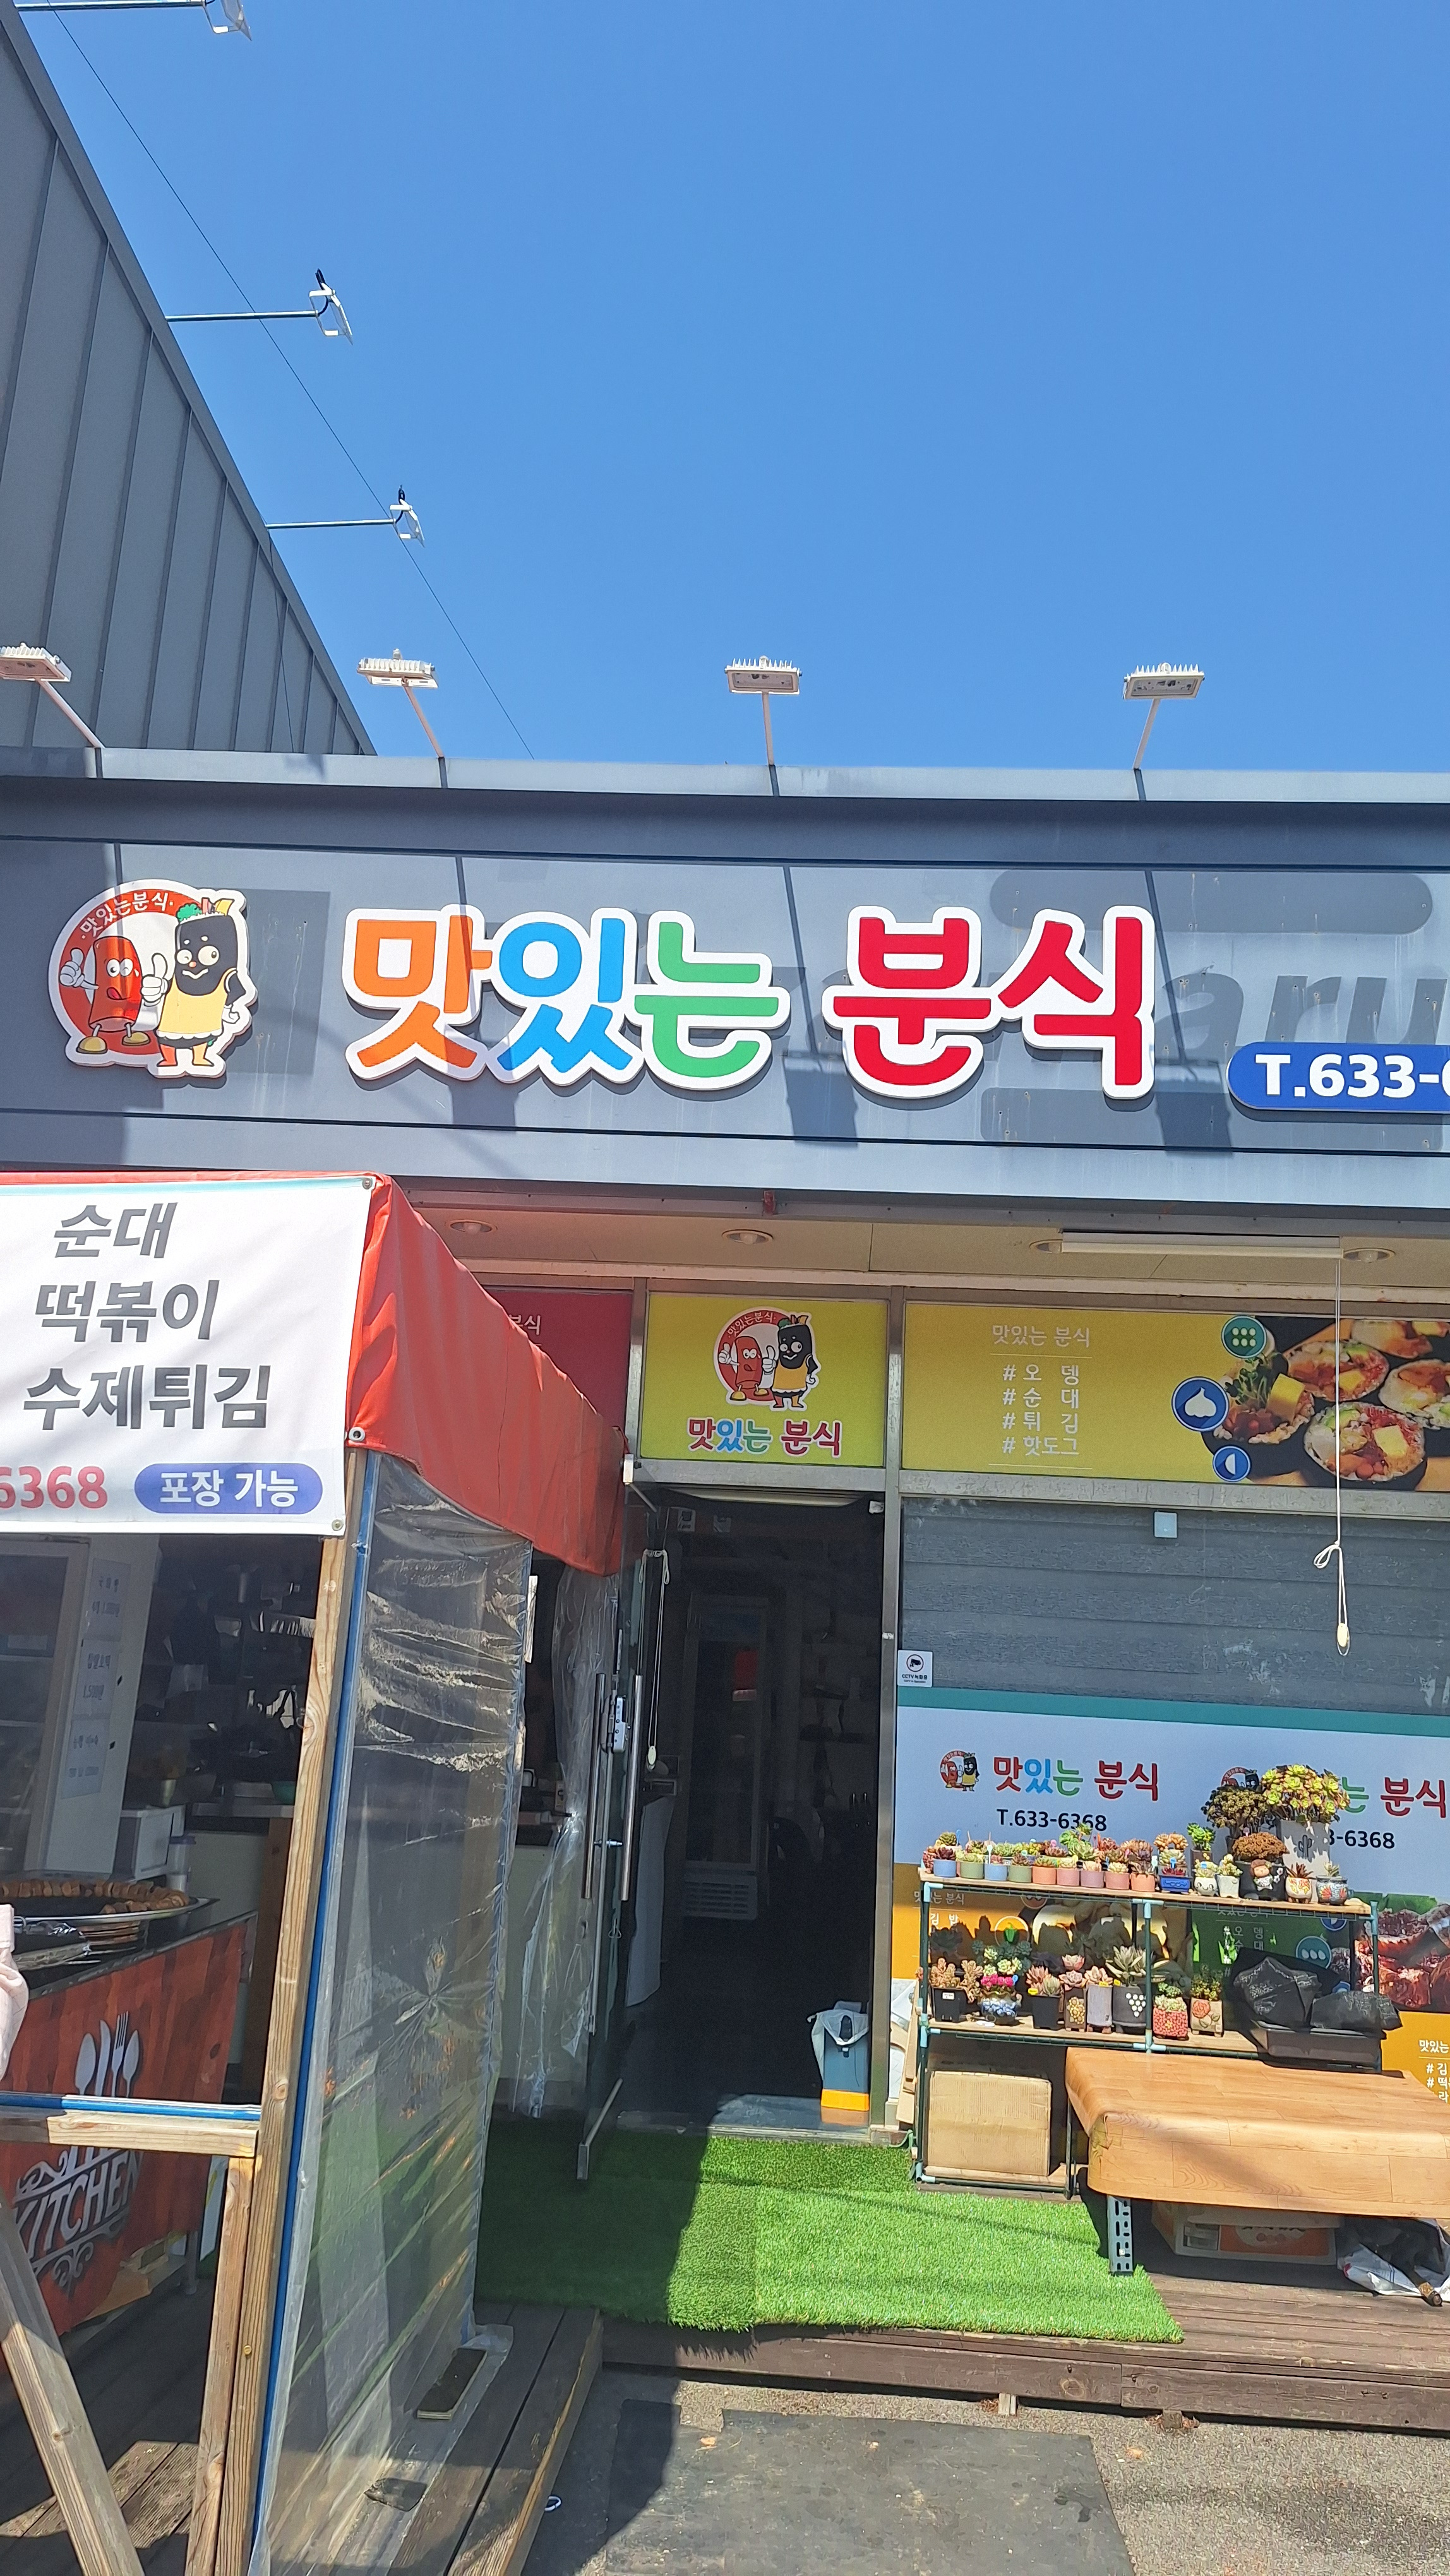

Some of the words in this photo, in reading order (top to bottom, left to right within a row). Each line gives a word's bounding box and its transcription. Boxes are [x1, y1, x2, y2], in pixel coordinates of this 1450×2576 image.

[80, 891, 169, 937] 맛있는분식
[352, 914, 779, 1078] 맛있는
[833, 915, 1144, 1087] 분식
[1255, 1053, 1450, 1099] T.633-
[54, 1202, 178, 1259] 순대
[35, 1279, 220, 1342] 떡볶이
[727, 1311, 774, 1337] 맛있는분식
[992, 1325, 1047, 1347] 맛있는
[1053, 1327, 1089, 1348] 분식
[23, 1364, 271, 1430] 수제튀김
[689, 1418, 772, 1453] 맛있는
[781, 1420, 841, 1456] 분식
[160, 1470, 223, 1507] 포장
[235, 1469, 298, 1507] 가능
[993, 1756, 1083, 1796] 맛있는
[1094, 1760, 1158, 1801] 분식
[1381, 1777, 1446, 1818] 분식
[996, 1808, 1107, 1832] T.633-6368
[945, 1892, 964, 1905] 분식
[1419, 2039, 1449, 2054] 맛있는
